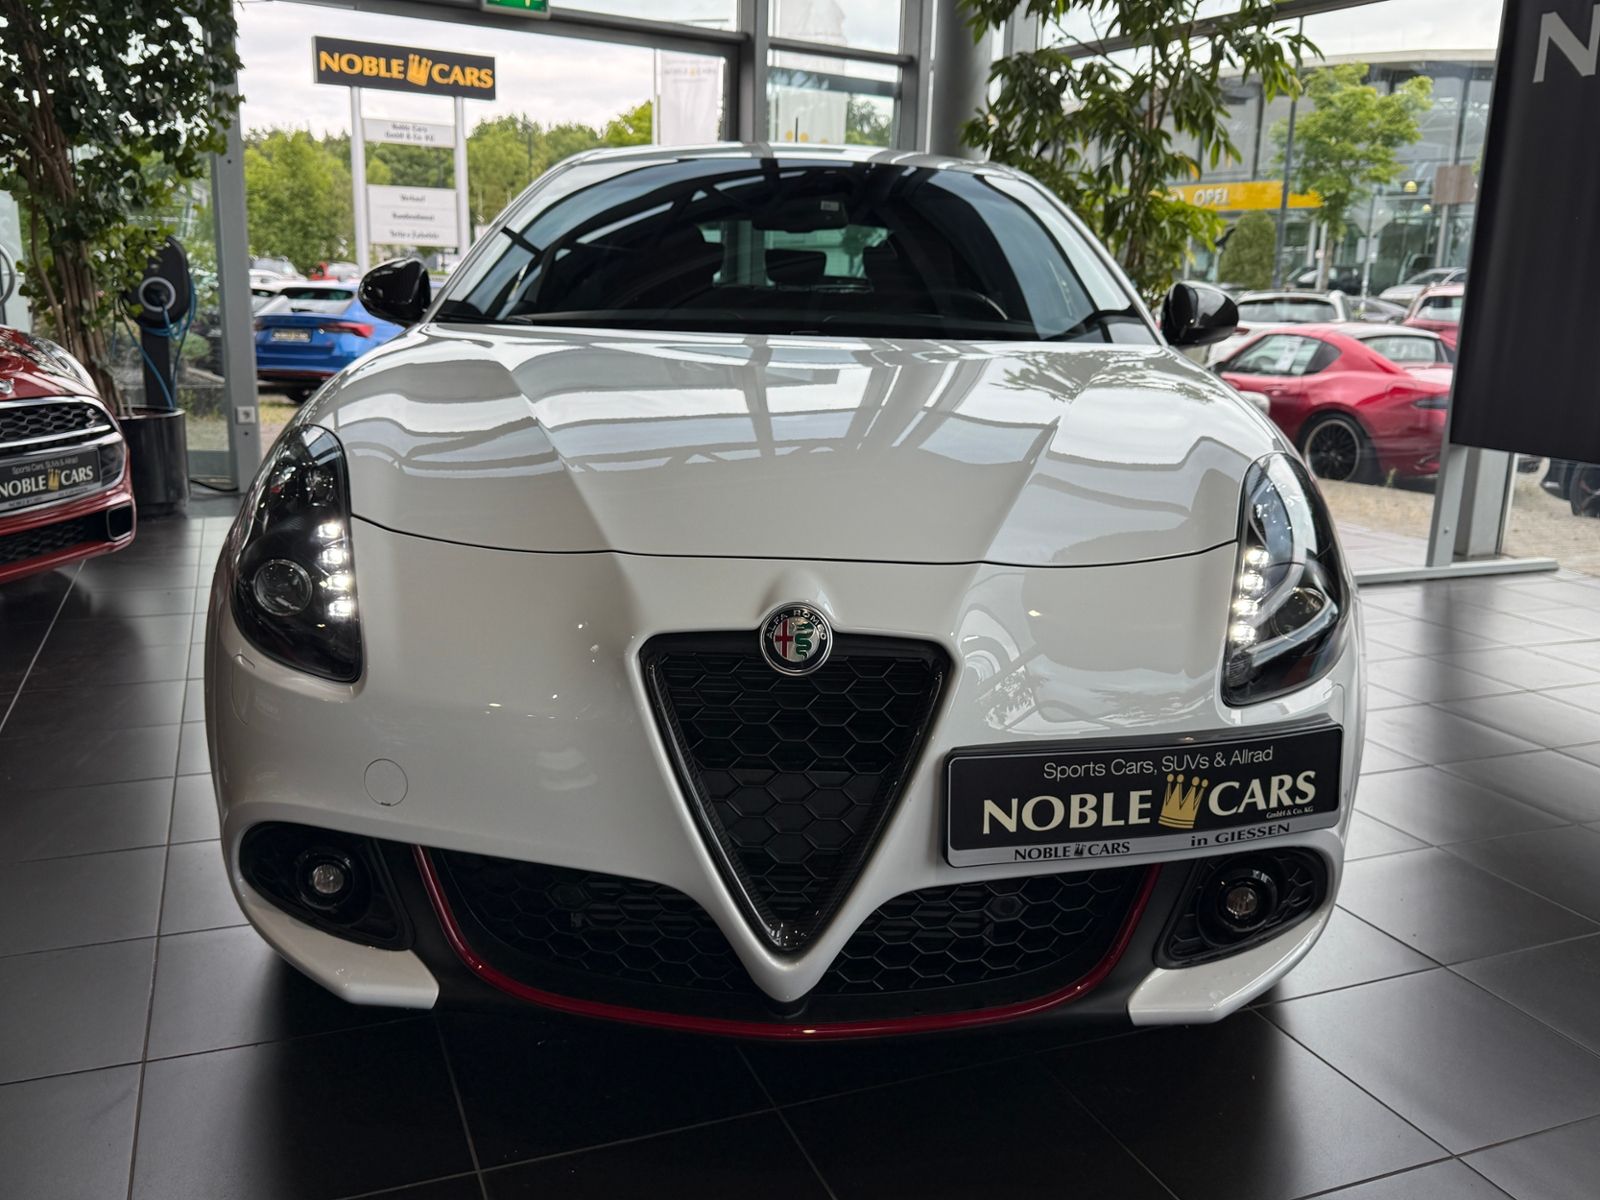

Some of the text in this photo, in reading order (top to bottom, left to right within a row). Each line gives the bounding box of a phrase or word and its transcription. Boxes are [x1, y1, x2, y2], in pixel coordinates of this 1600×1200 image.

[319, 51, 494, 88] NOBLE CARS
[0, 475, 46, 498] NOBLE
[61, 465, 93, 485] CARS
[766, 613, 788, 639] ALFA
[1043, 745, 1274, 782] Sports Cars, SUVs & Allrad
[982, 770, 1317, 836] NOBLE CARS
[1014, 841, 1130, 861] NOBLE CARS
[1191, 822, 1290, 847] in GIESSEN
